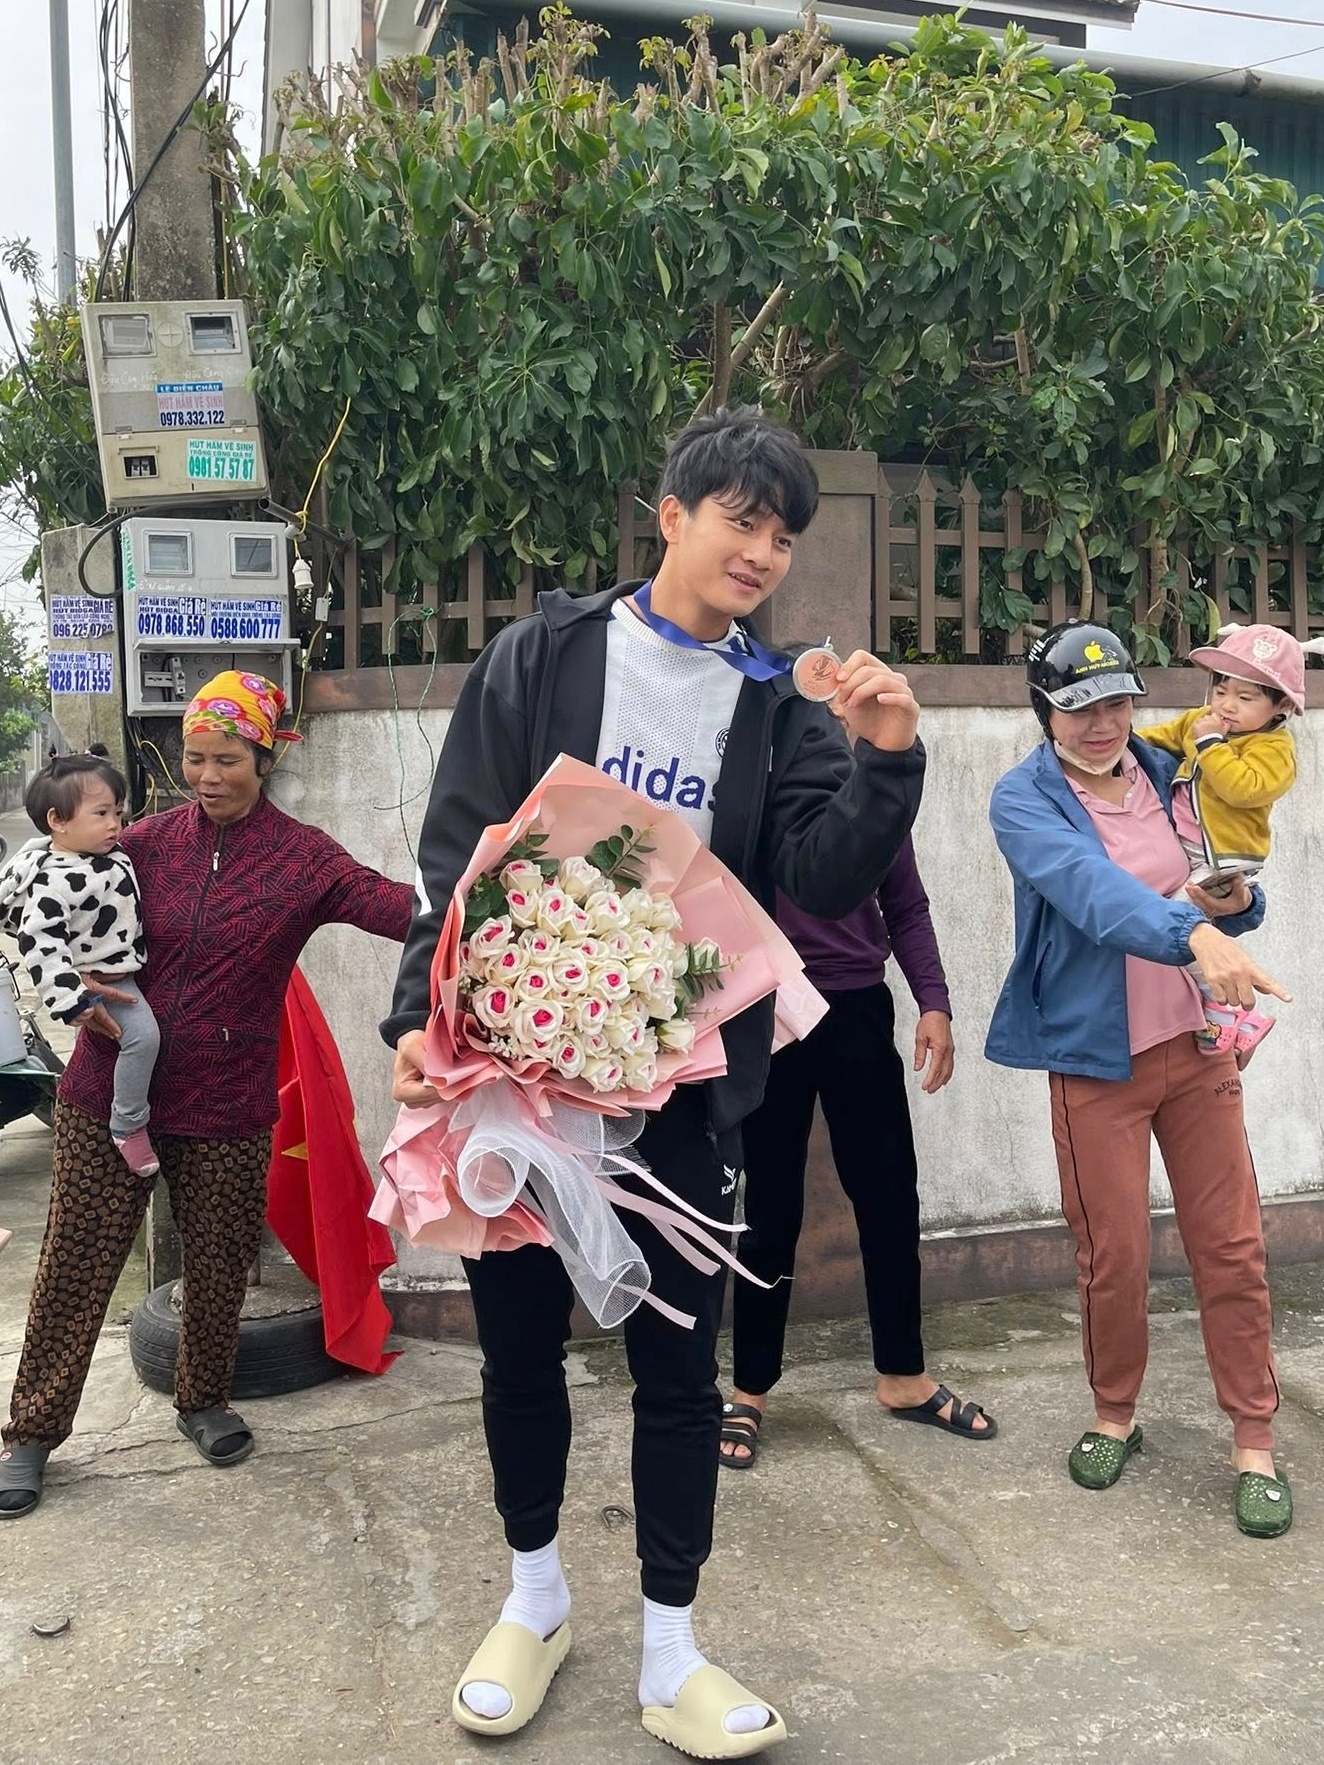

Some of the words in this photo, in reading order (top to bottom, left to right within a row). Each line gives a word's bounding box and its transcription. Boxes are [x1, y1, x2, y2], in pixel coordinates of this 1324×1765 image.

[206, 396, 222, 408] SINH
[160, 410, 224, 426] 0978.332.122
[236, 443, 253, 452] SINH
[180, 598, 193, 614] Giá
[256, 601, 268, 611] Giá
[139, 613, 205, 636] 0978.868.550
[211, 618, 280, 639] 0588.600.777
